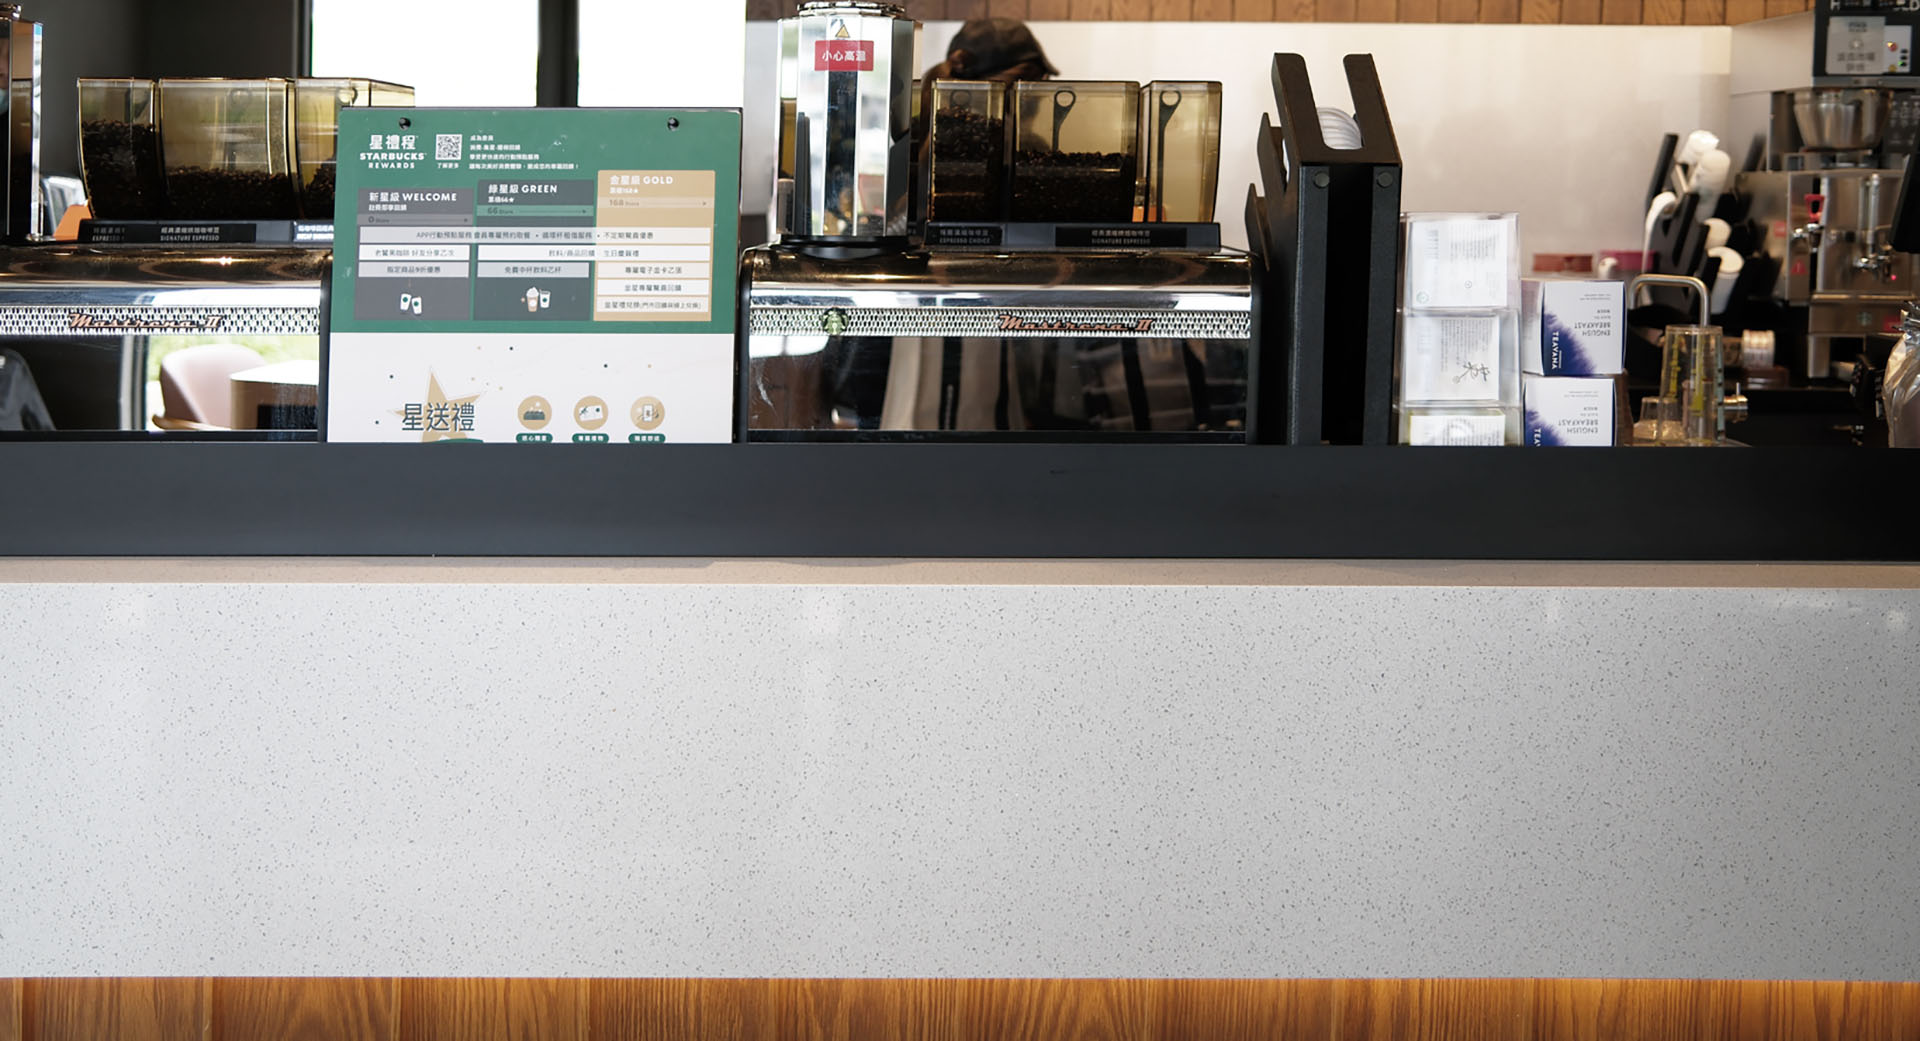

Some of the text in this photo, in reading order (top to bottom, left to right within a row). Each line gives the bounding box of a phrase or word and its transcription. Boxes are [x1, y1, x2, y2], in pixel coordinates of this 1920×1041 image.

[822, 50, 866, 61] 小心高溫
[369, 134, 417, 150] 星禮程
[360, 152, 425, 161] STARBUCKS
[610, 175, 674, 185] 金星級 GOLD
[488, 184, 558, 194] 綠星級 GREEN
[369, 192, 457, 202] 新星級 WELCOME
[1582, 329, 1611, 337] ENGLISH
[1551, 331, 1559, 370] TEAVANA
[402, 402, 475, 432] 星送禮
[1558, 419, 1599, 427] BREAKFAST
[1566, 426, 1599, 435] ENGLISH
